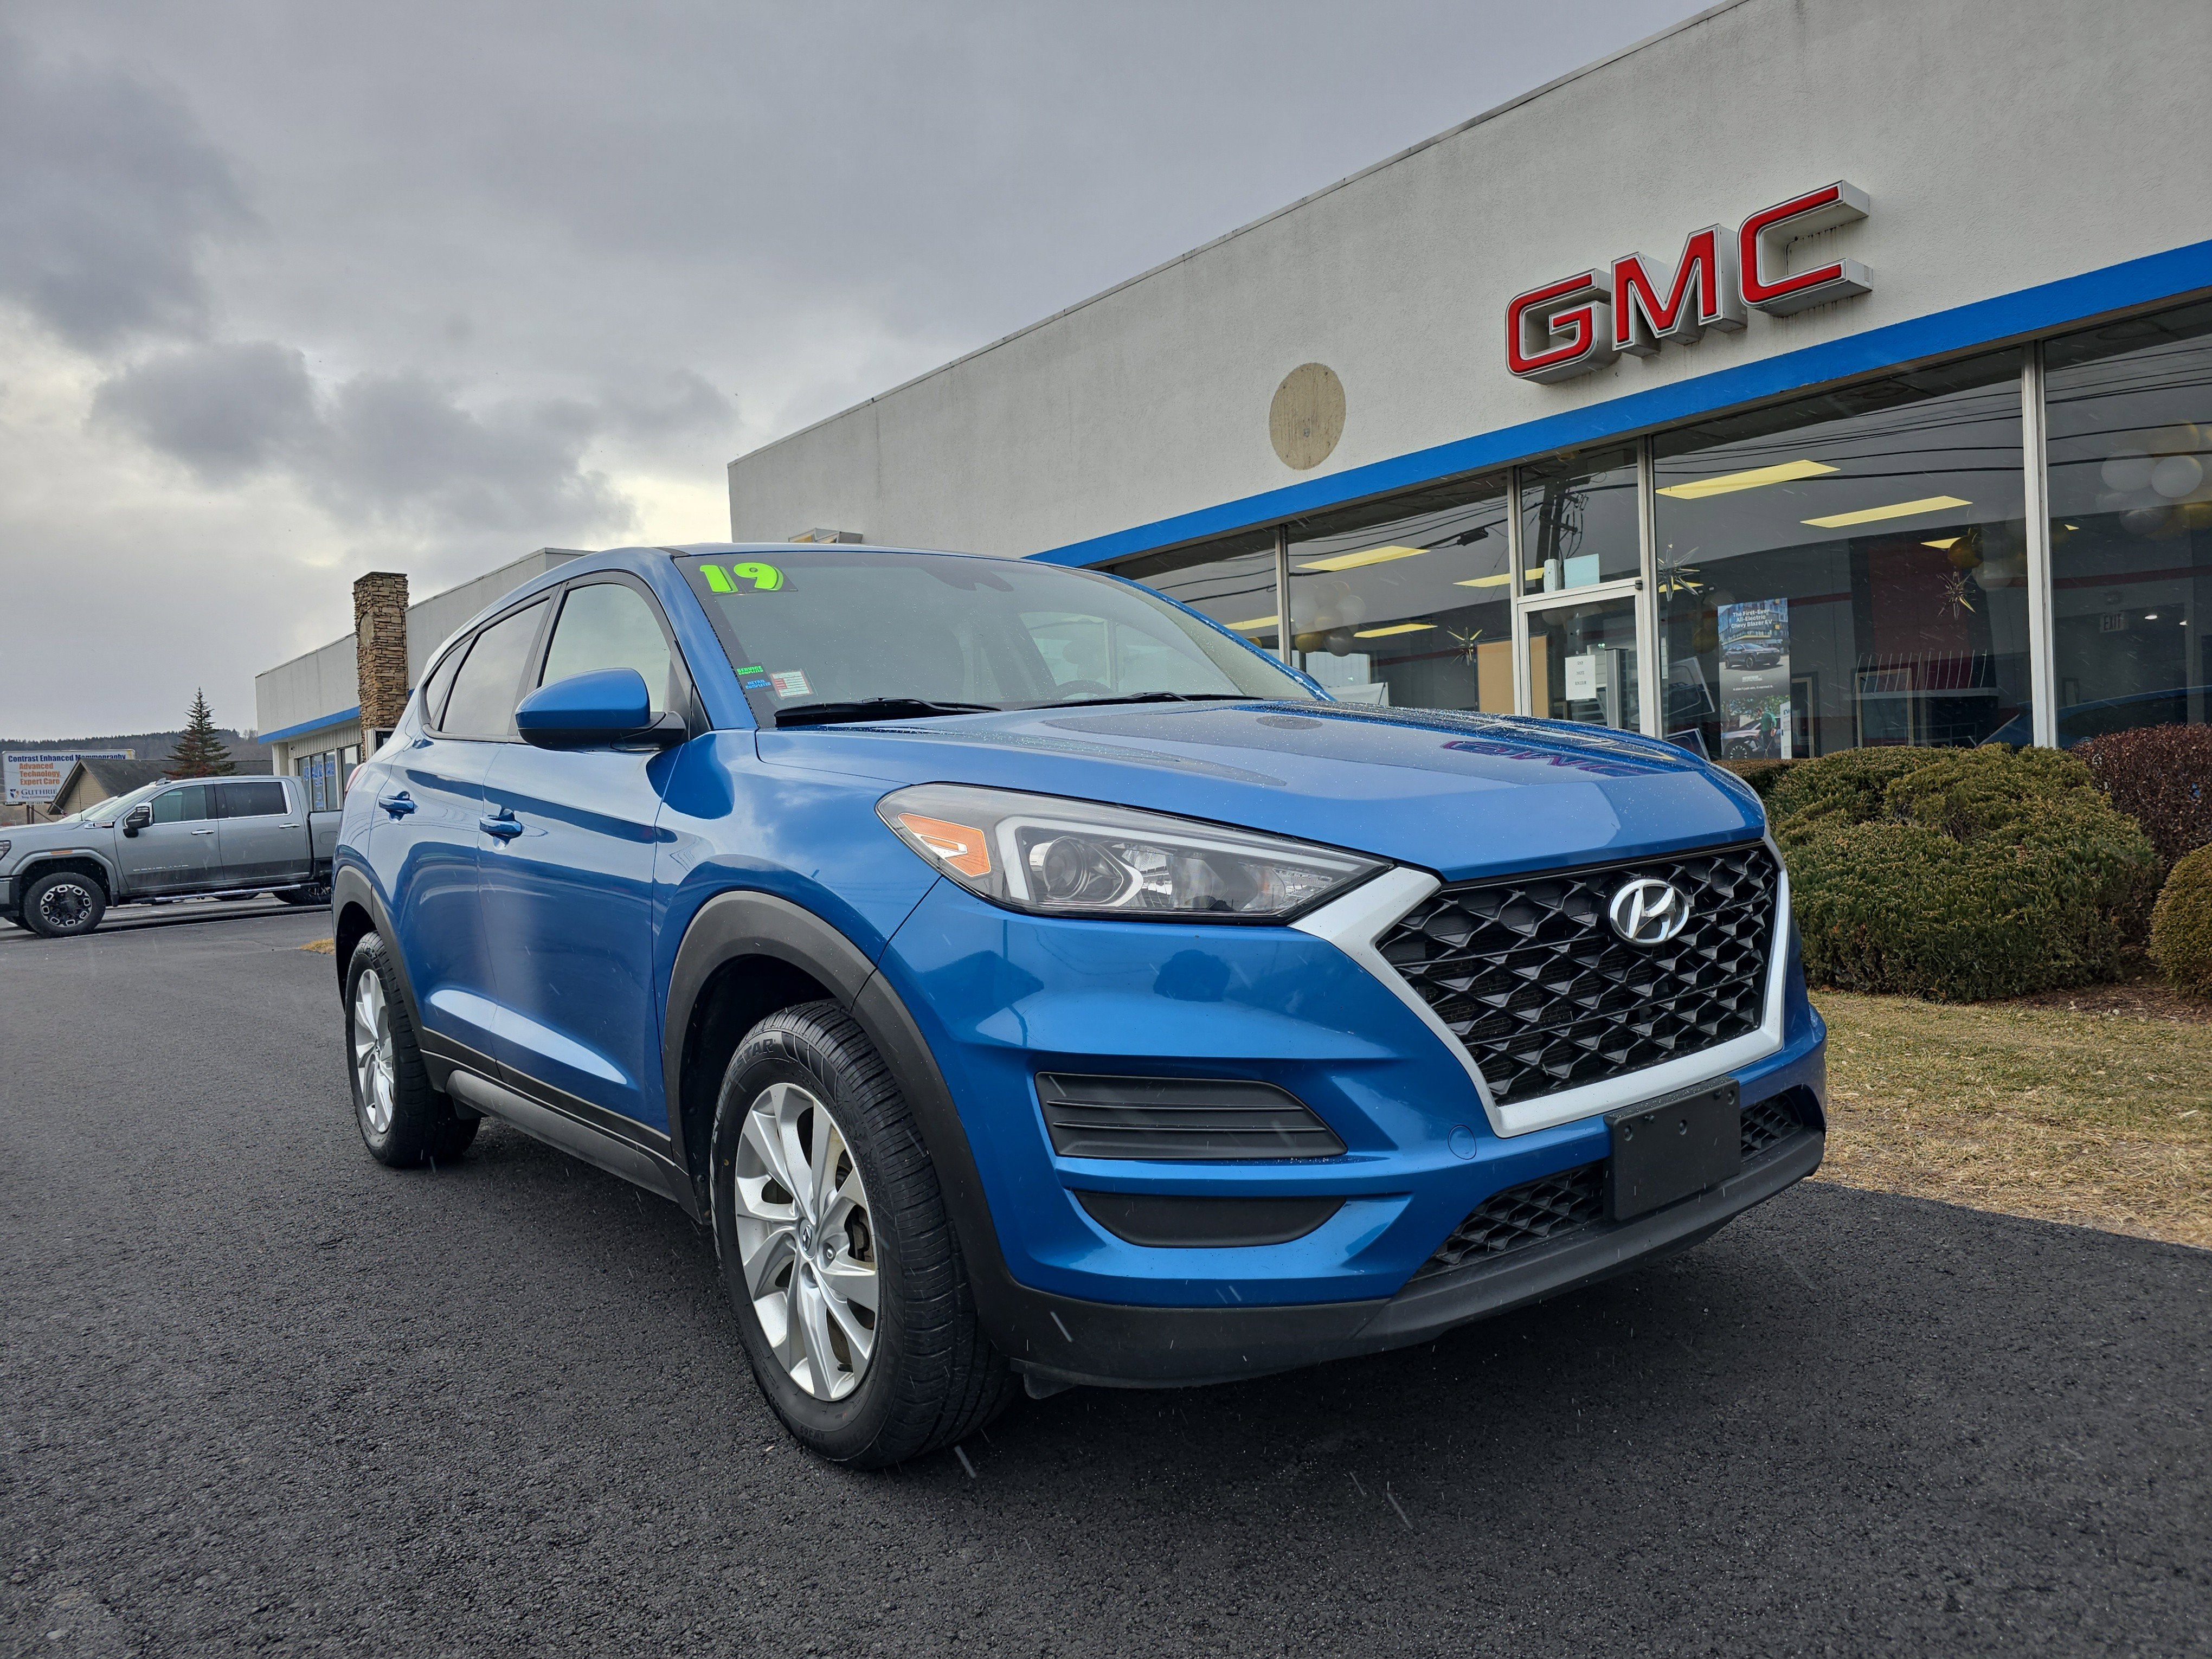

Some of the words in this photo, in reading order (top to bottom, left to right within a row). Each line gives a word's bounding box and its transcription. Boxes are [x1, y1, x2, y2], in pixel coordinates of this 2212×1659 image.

[1506, 179, 1860, 381] GMC
[700, 562, 784, 593] 19
[2104, 613, 2121, 631] EXIT
